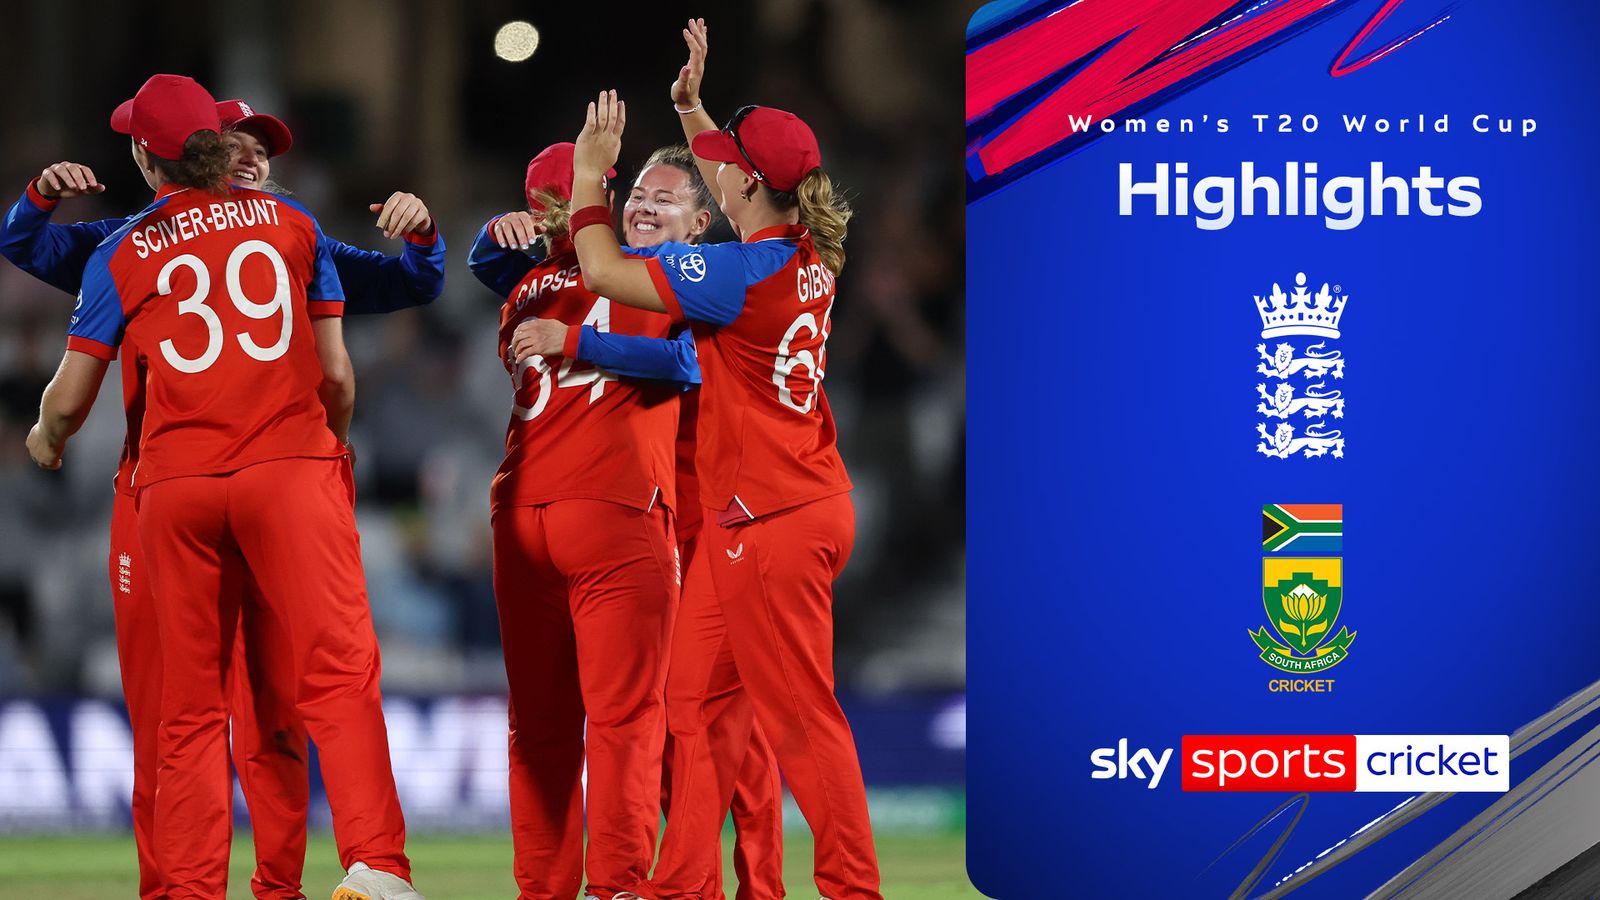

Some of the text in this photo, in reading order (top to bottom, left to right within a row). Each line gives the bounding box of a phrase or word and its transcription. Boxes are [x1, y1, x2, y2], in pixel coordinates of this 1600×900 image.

[131, 199, 281, 260] SCIVER-BRUNT
[157, 239, 293, 374] 39
[515, 264, 581, 311] CAPSE
